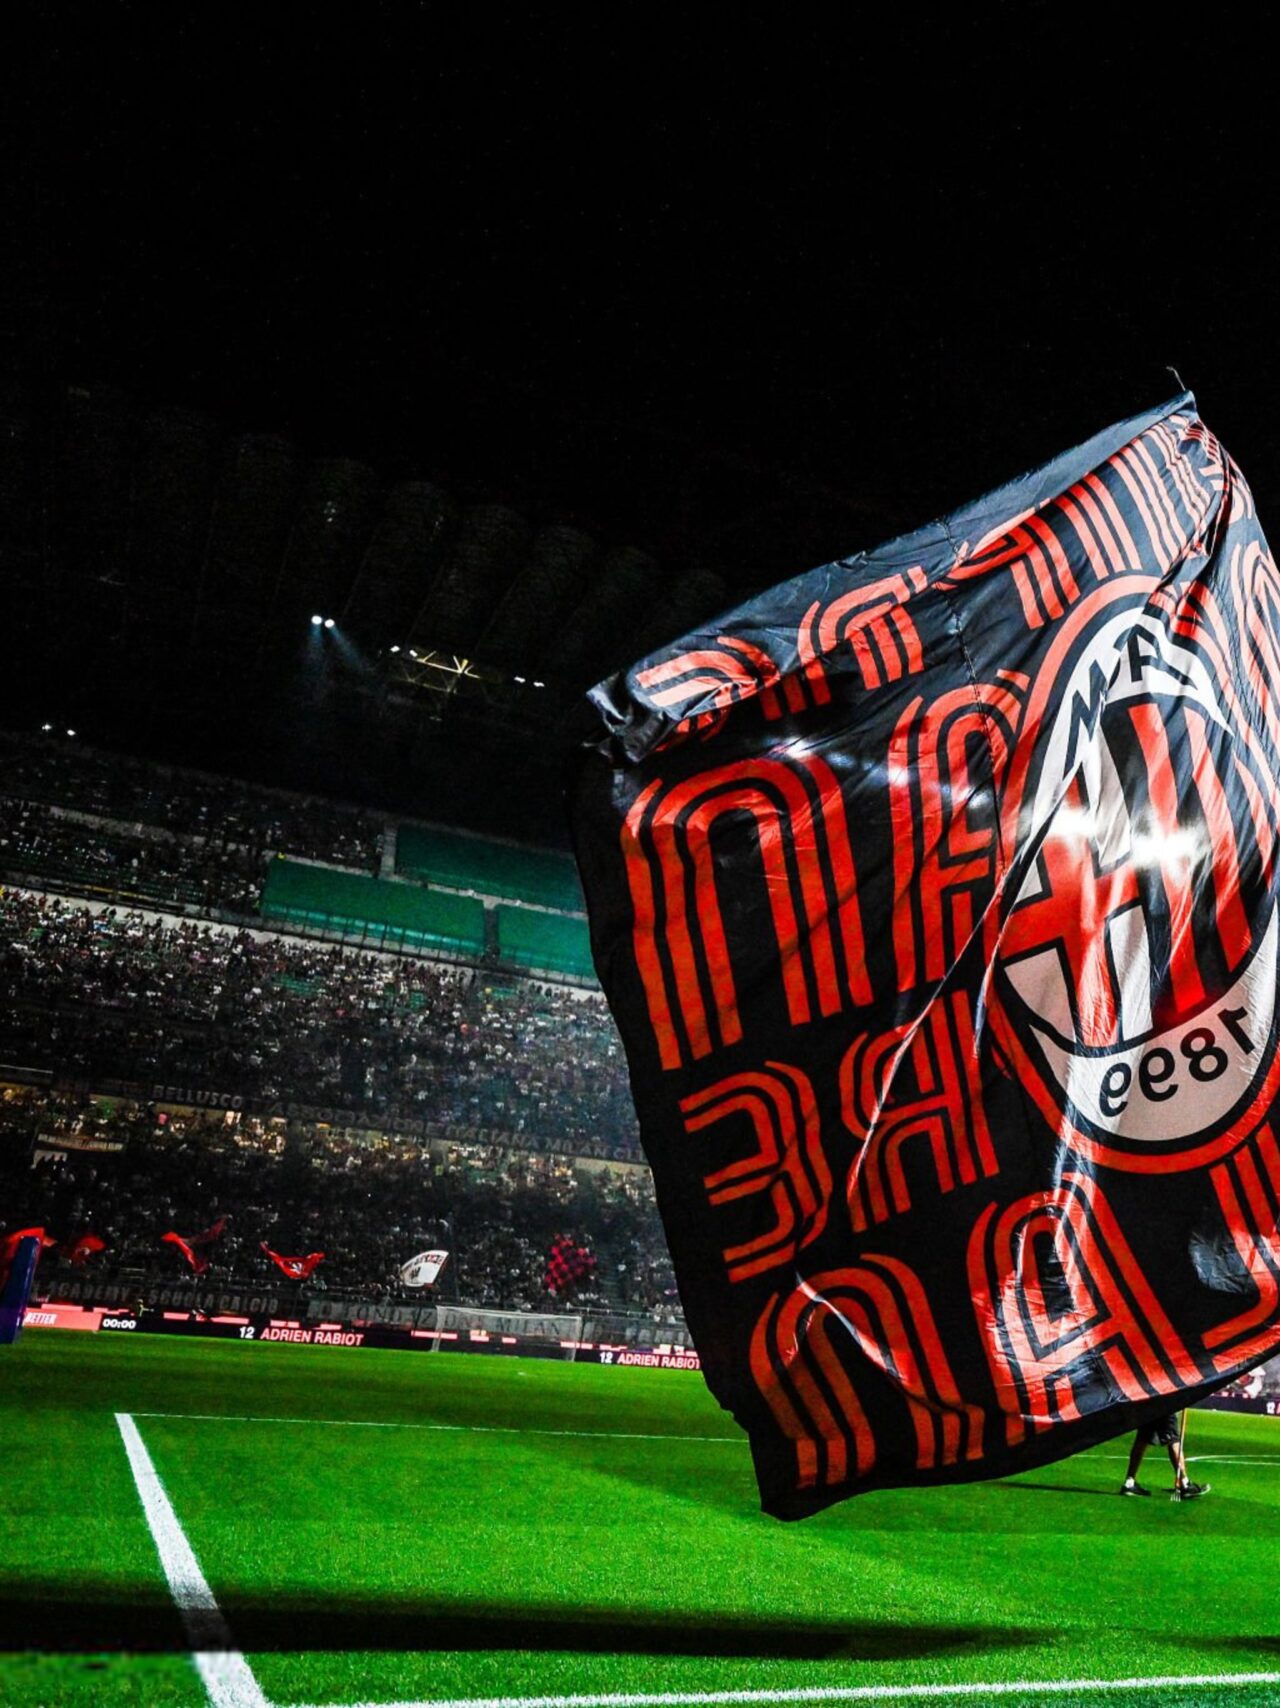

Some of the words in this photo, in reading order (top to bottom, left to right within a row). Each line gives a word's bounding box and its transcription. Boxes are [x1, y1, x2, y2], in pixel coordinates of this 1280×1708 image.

[153, 1084, 243, 1108] BELLUSCO
[103, 1318, 136, 1330] 00:00
[239, 1326, 254, 1339] 12
[260, 1328, 312, 1343] ADRIEN
[314, 1331, 364, 1346] RABIOT
[600, 1352, 613, 1364] 12
[617, 1352, 659, 1367] ADRIEN
[1266, 1402, 1275, 1415] 12
